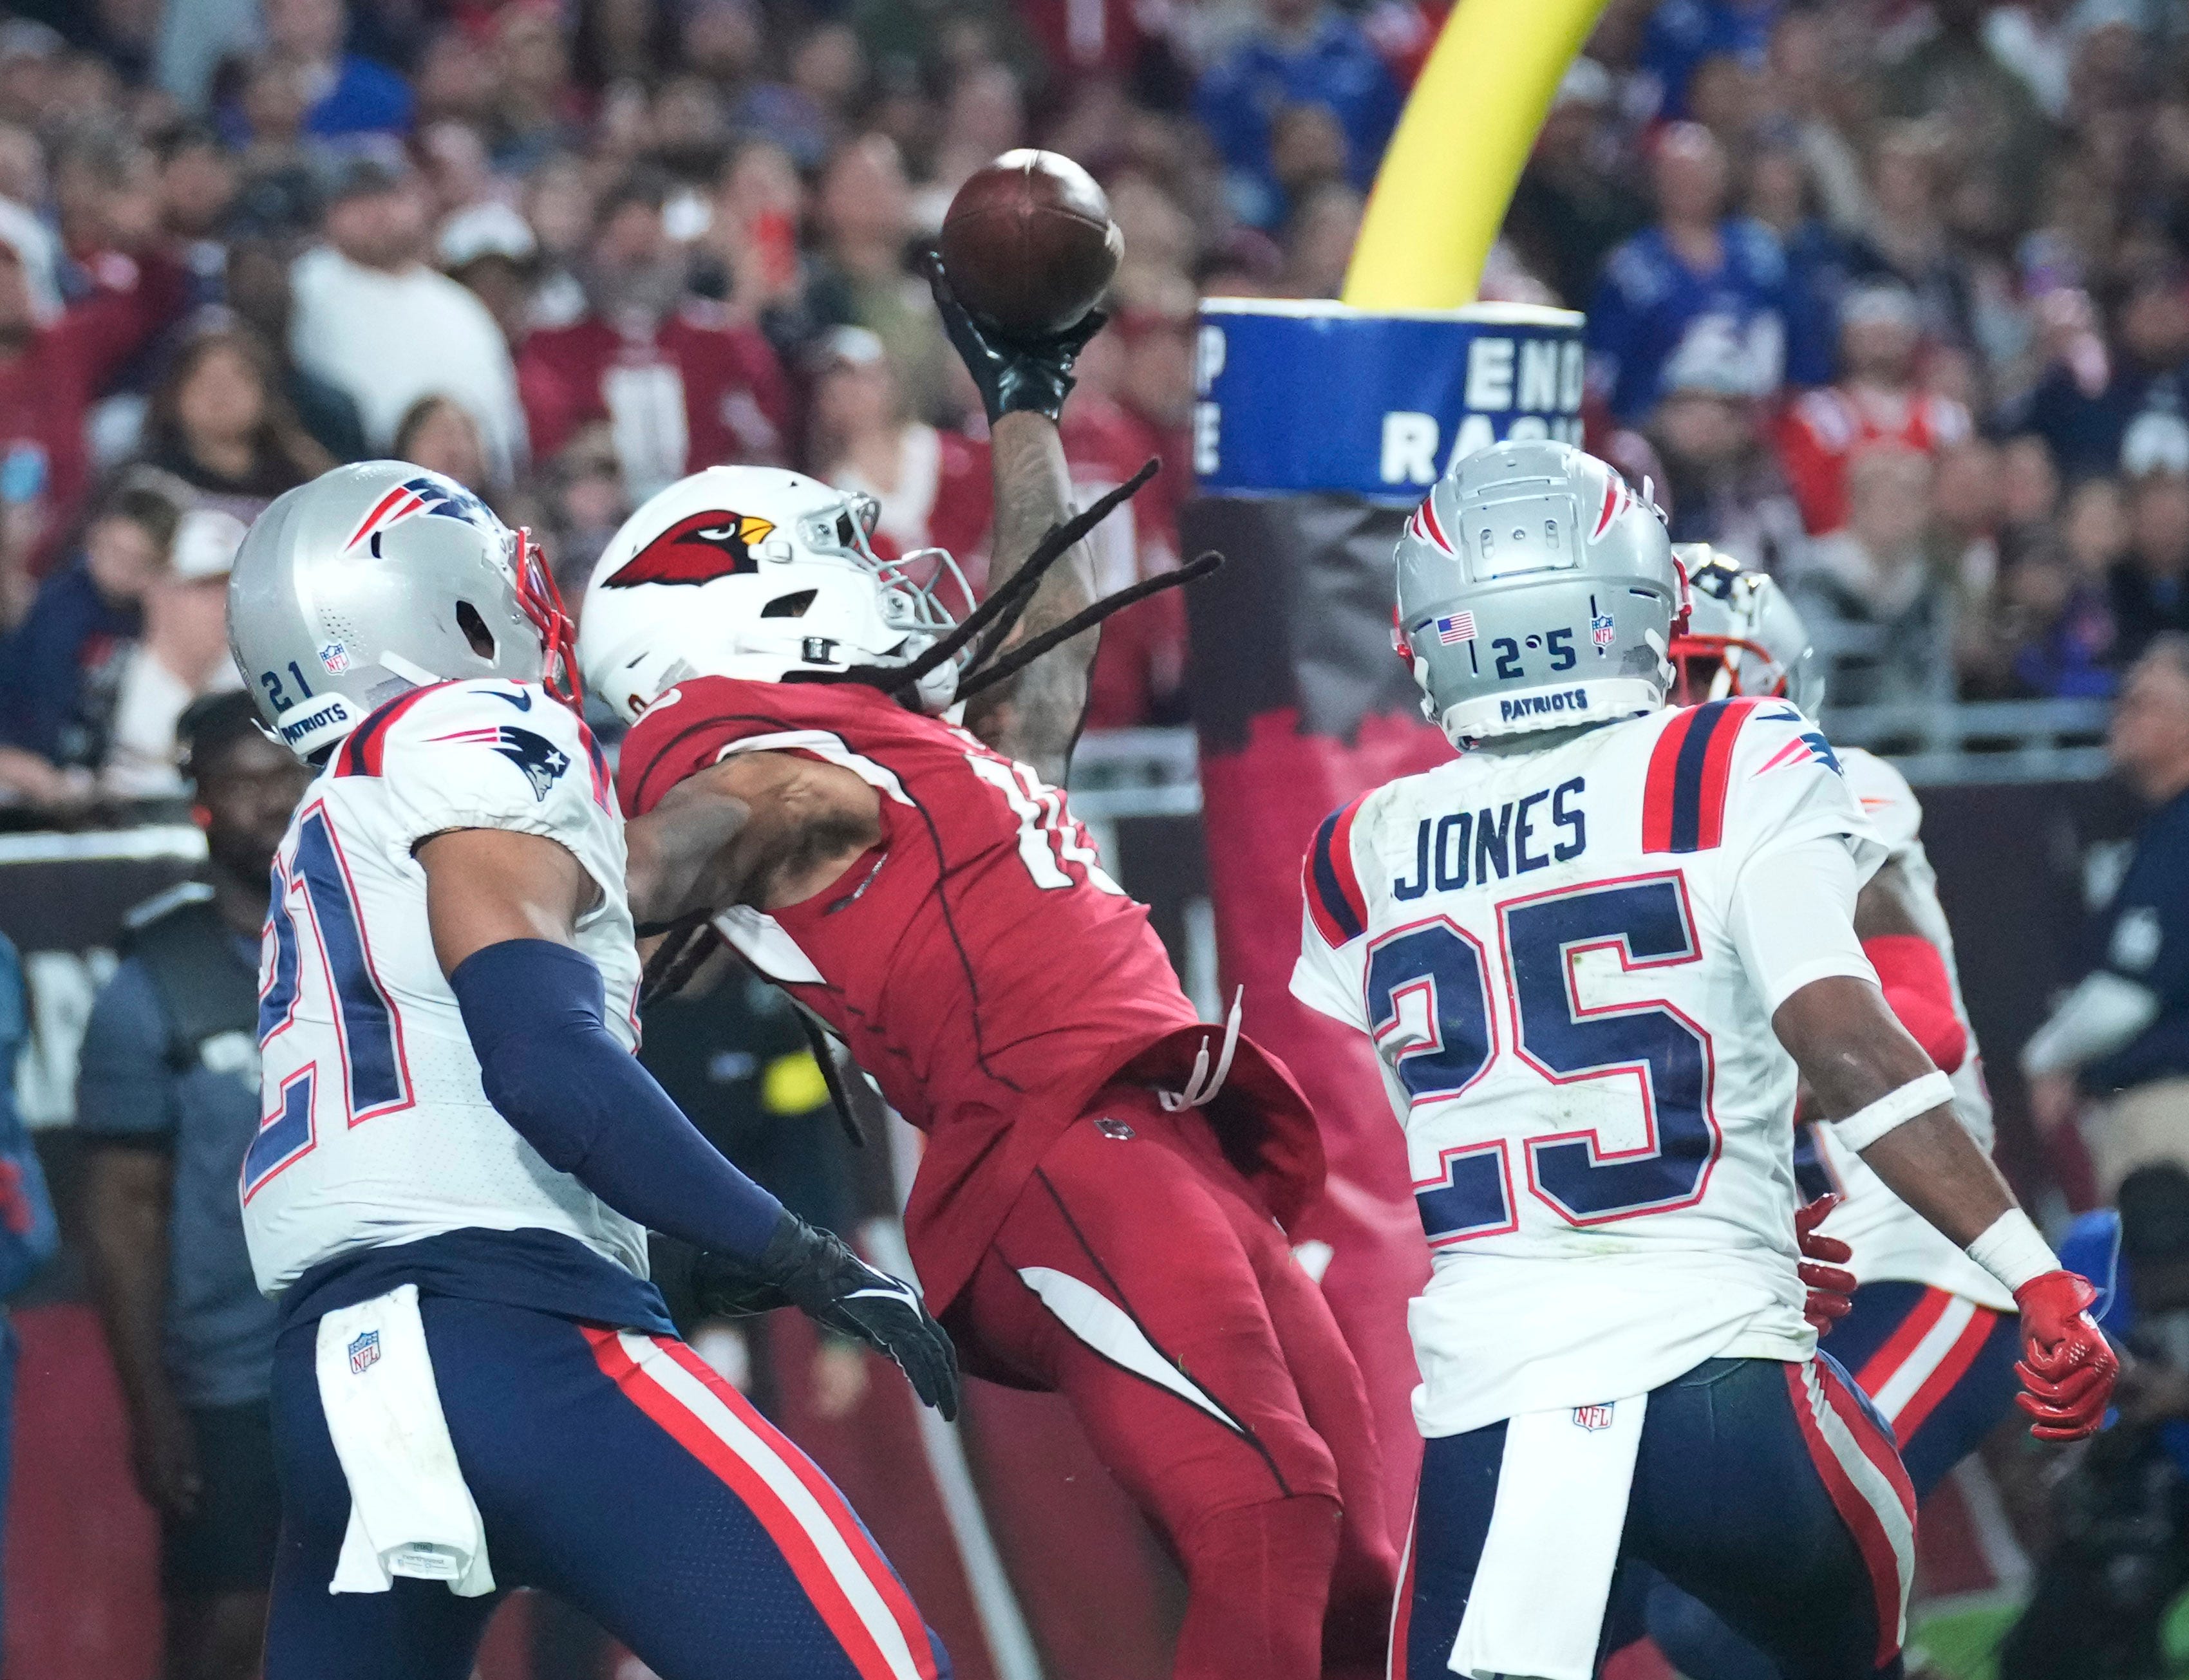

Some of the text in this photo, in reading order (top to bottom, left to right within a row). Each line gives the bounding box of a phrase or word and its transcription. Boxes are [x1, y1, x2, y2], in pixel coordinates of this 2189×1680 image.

[1595, 628, 1613, 642] NFL
[326, 655, 348, 672] NFL
[261, 660, 314, 714] 21
[1500, 688, 1588, 722] PATRIOTS
[1394, 776, 1587, 901] JONES
[243, 797, 416, 1208] 21
[1364, 868, 1723, 1249] 25
[353, 1345, 379, 1371] NFL
[1577, 1406, 1609, 1427] NFL
